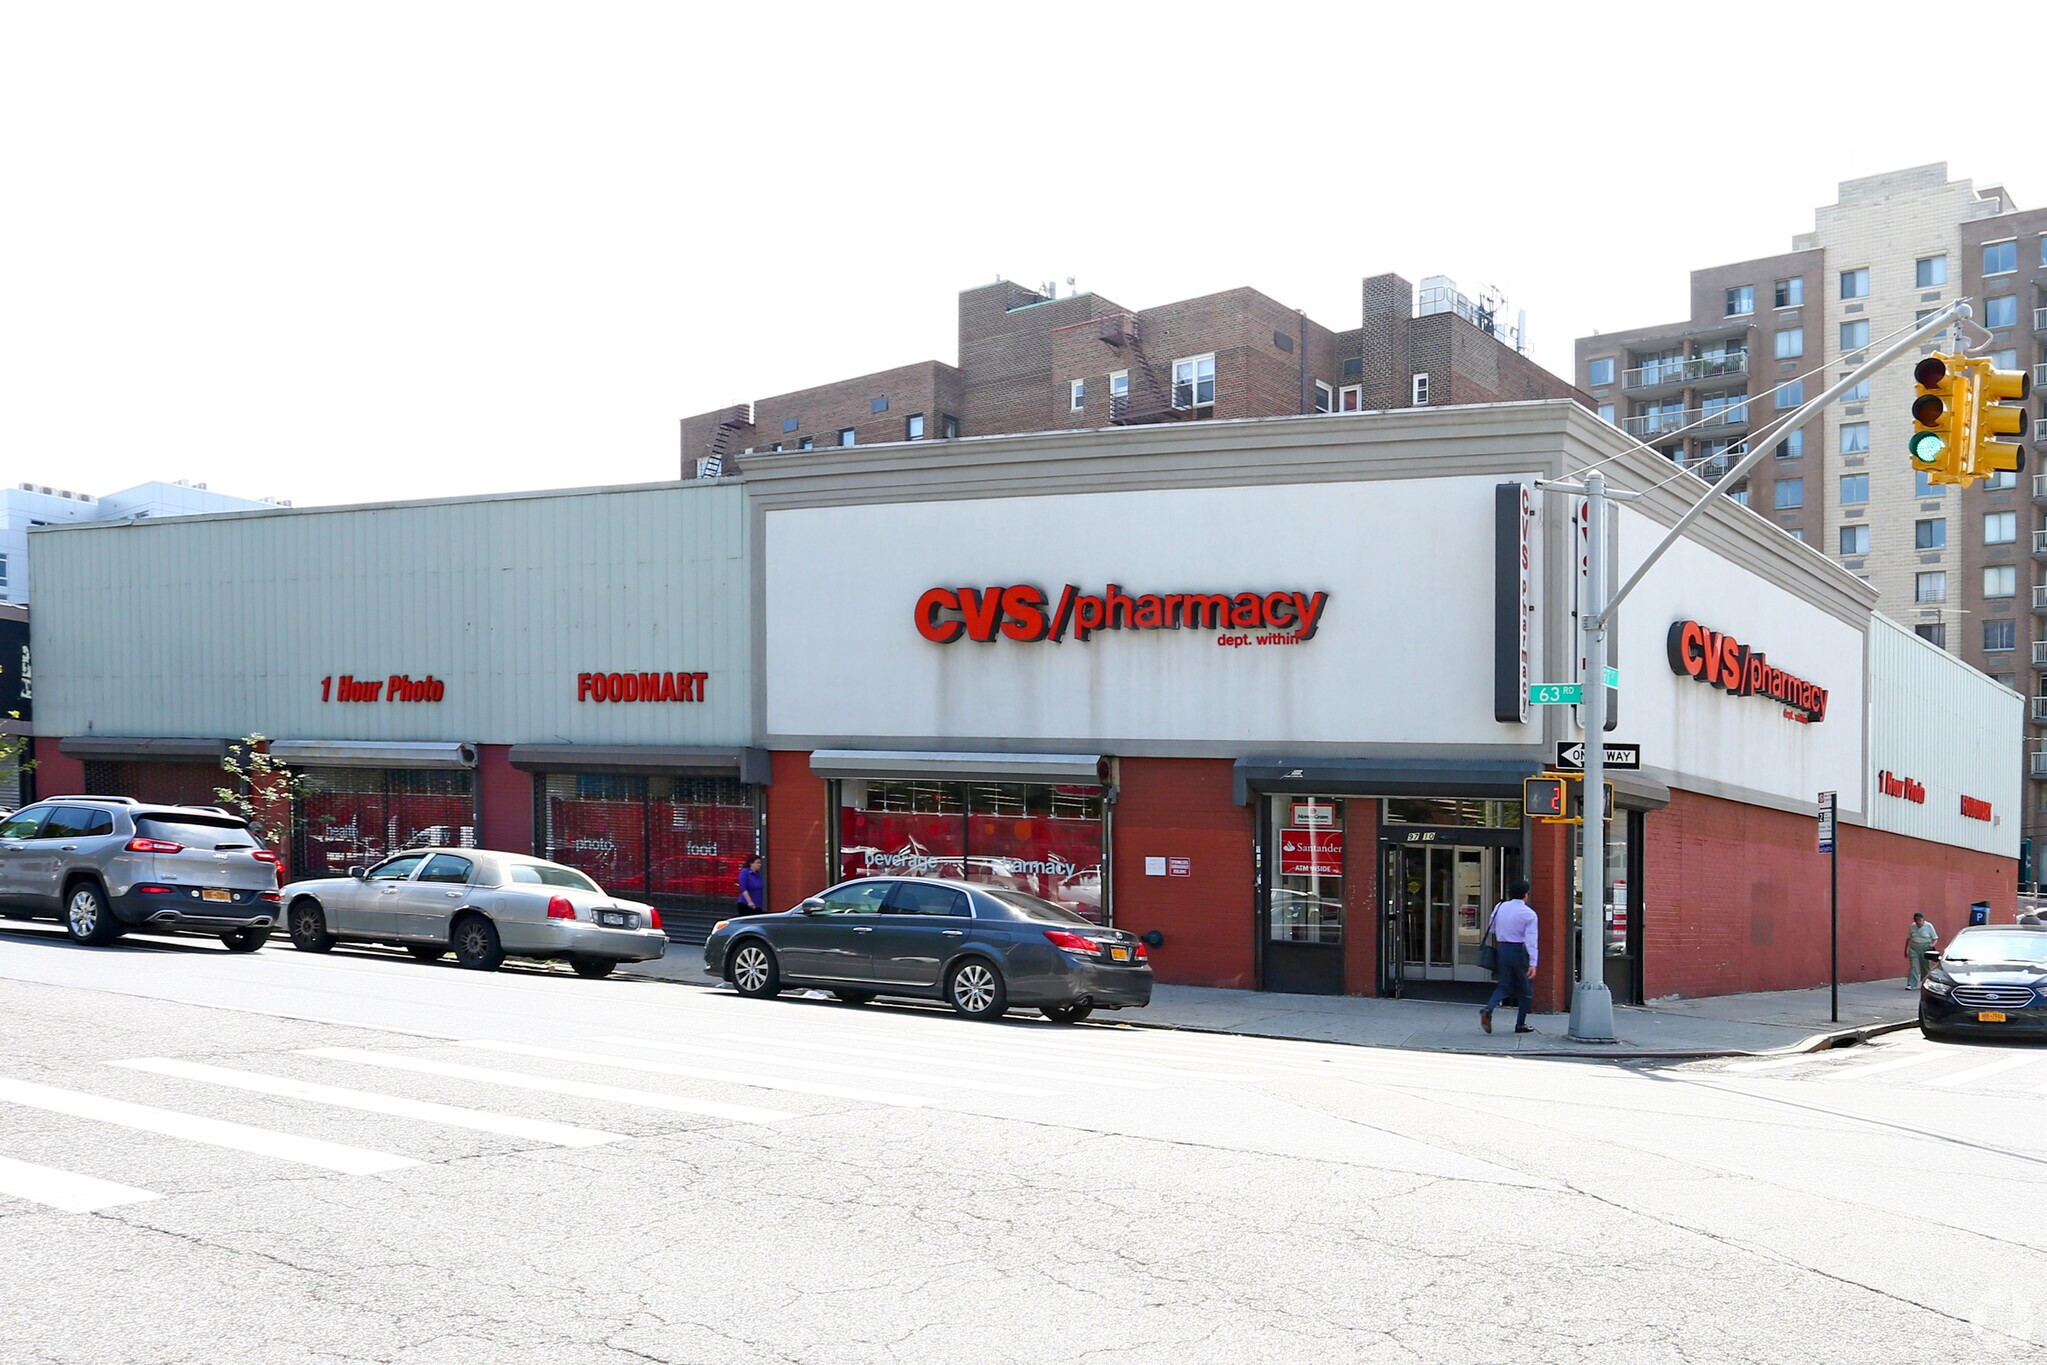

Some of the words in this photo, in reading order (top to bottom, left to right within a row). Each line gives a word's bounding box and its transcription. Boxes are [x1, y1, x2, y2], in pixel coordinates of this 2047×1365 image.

[1521, 488, 1529, 570] CVS
[1217, 633, 1252, 648] dept.
[1256, 632, 1299, 645] within
[322, 676, 331, 702] 1
[337, 676, 382, 702] Hour
[386, 675, 445, 702] Photo
[577, 672, 708, 702] FOODMART
[1539, 686, 1560, 702] 63
[1563, 686, 1574, 695] RD
[1573, 750, 1586, 760] ON
[1606, 751, 1631, 761] WAY
[1552, 787, 1560, 810] 2
[575, 836, 614, 852] photo
[1408, 832, 1420, 841] 97
[686, 841, 718, 857] food
[1297, 842, 1343, 853] Santander
[864, 851, 937, 876] beverage
[1000, 856, 1076, 877] harmacy
[1295, 864, 1309, 872] ATM
[1976, 912, 1983, 922] P
